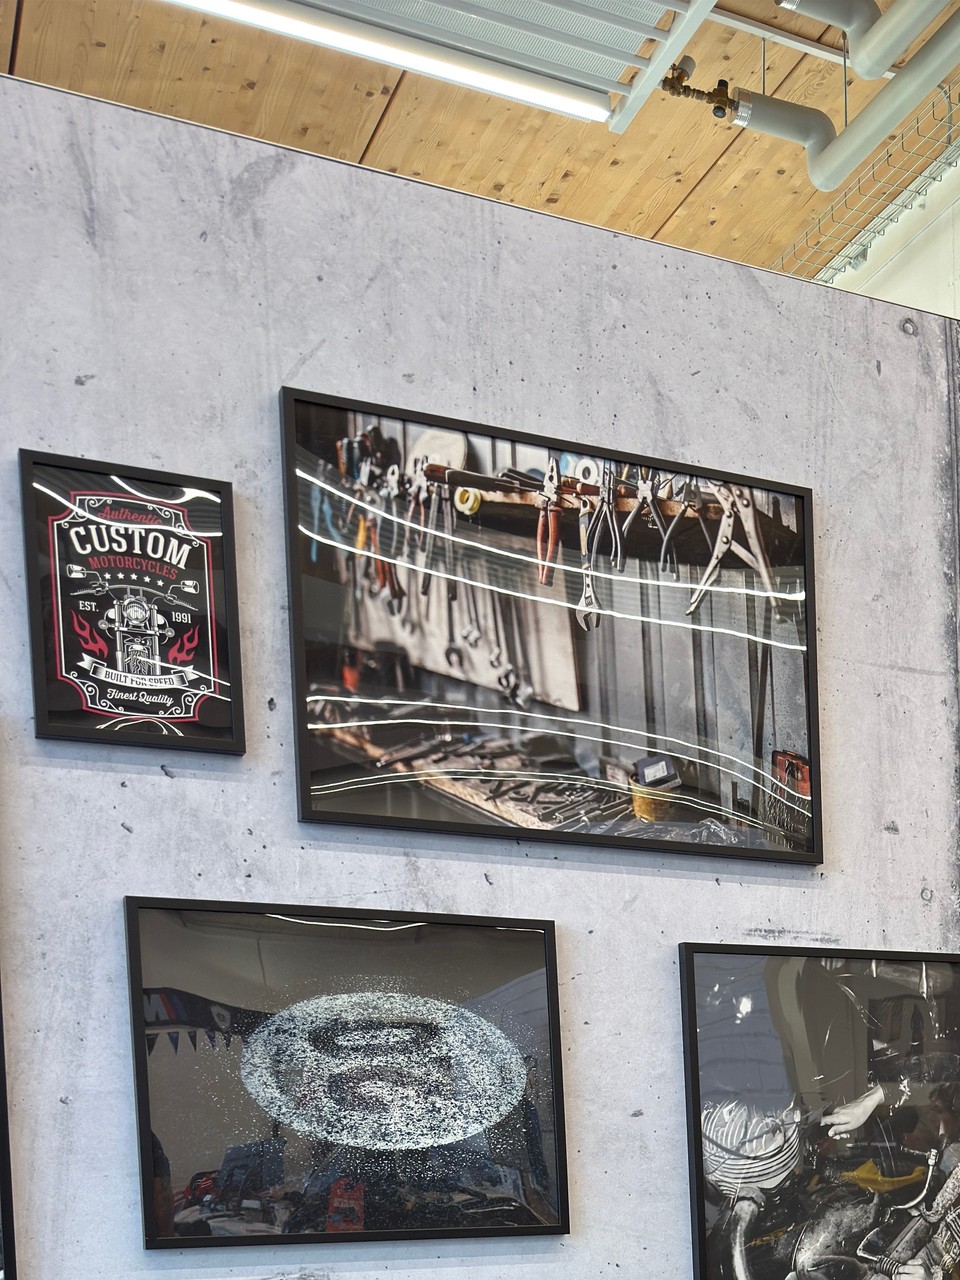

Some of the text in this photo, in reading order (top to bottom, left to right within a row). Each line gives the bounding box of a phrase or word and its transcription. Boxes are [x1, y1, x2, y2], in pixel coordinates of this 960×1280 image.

[69, 525, 192, 570] CUSTOM
[87, 557, 178, 580] MOTORCYCLES
[79, 600, 99, 612] EST.
[171, 611, 192, 624] 1991
[104, 670, 128, 684] BUILT
[106, 688, 174, 707] Finest Quality
